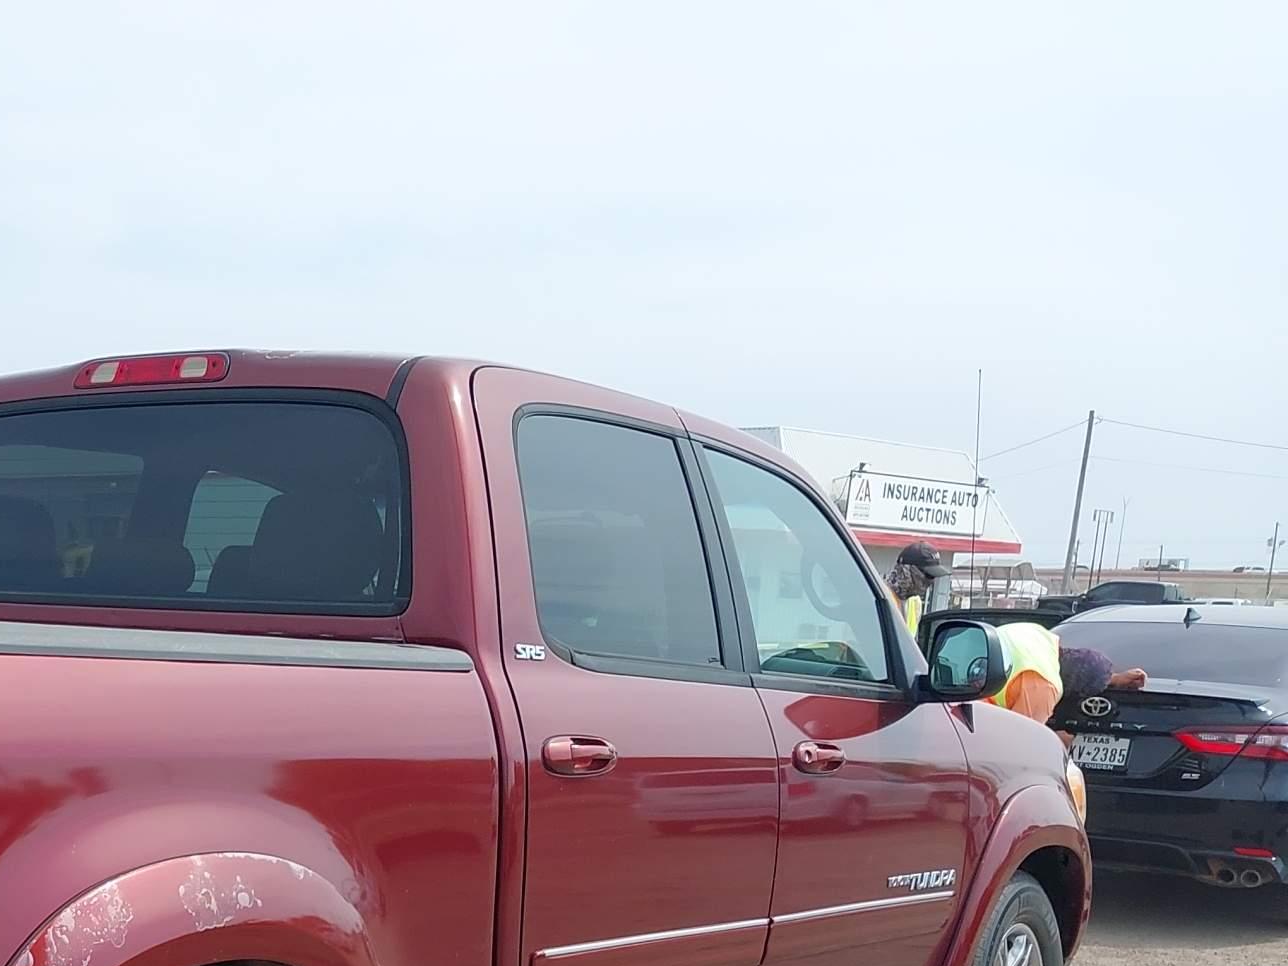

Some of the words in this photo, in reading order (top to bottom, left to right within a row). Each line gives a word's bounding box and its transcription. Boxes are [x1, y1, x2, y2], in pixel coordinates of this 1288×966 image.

[882, 481, 948, 505] INSURANCE
[950, 490, 979, 508] AUTO
[901, 505, 957, 525] AUCTIONS
[514, 643, 546, 661] SR5
[1082, 735, 1111, 745] TEXAS
[909, 868, 956, 891] TUNDRA
